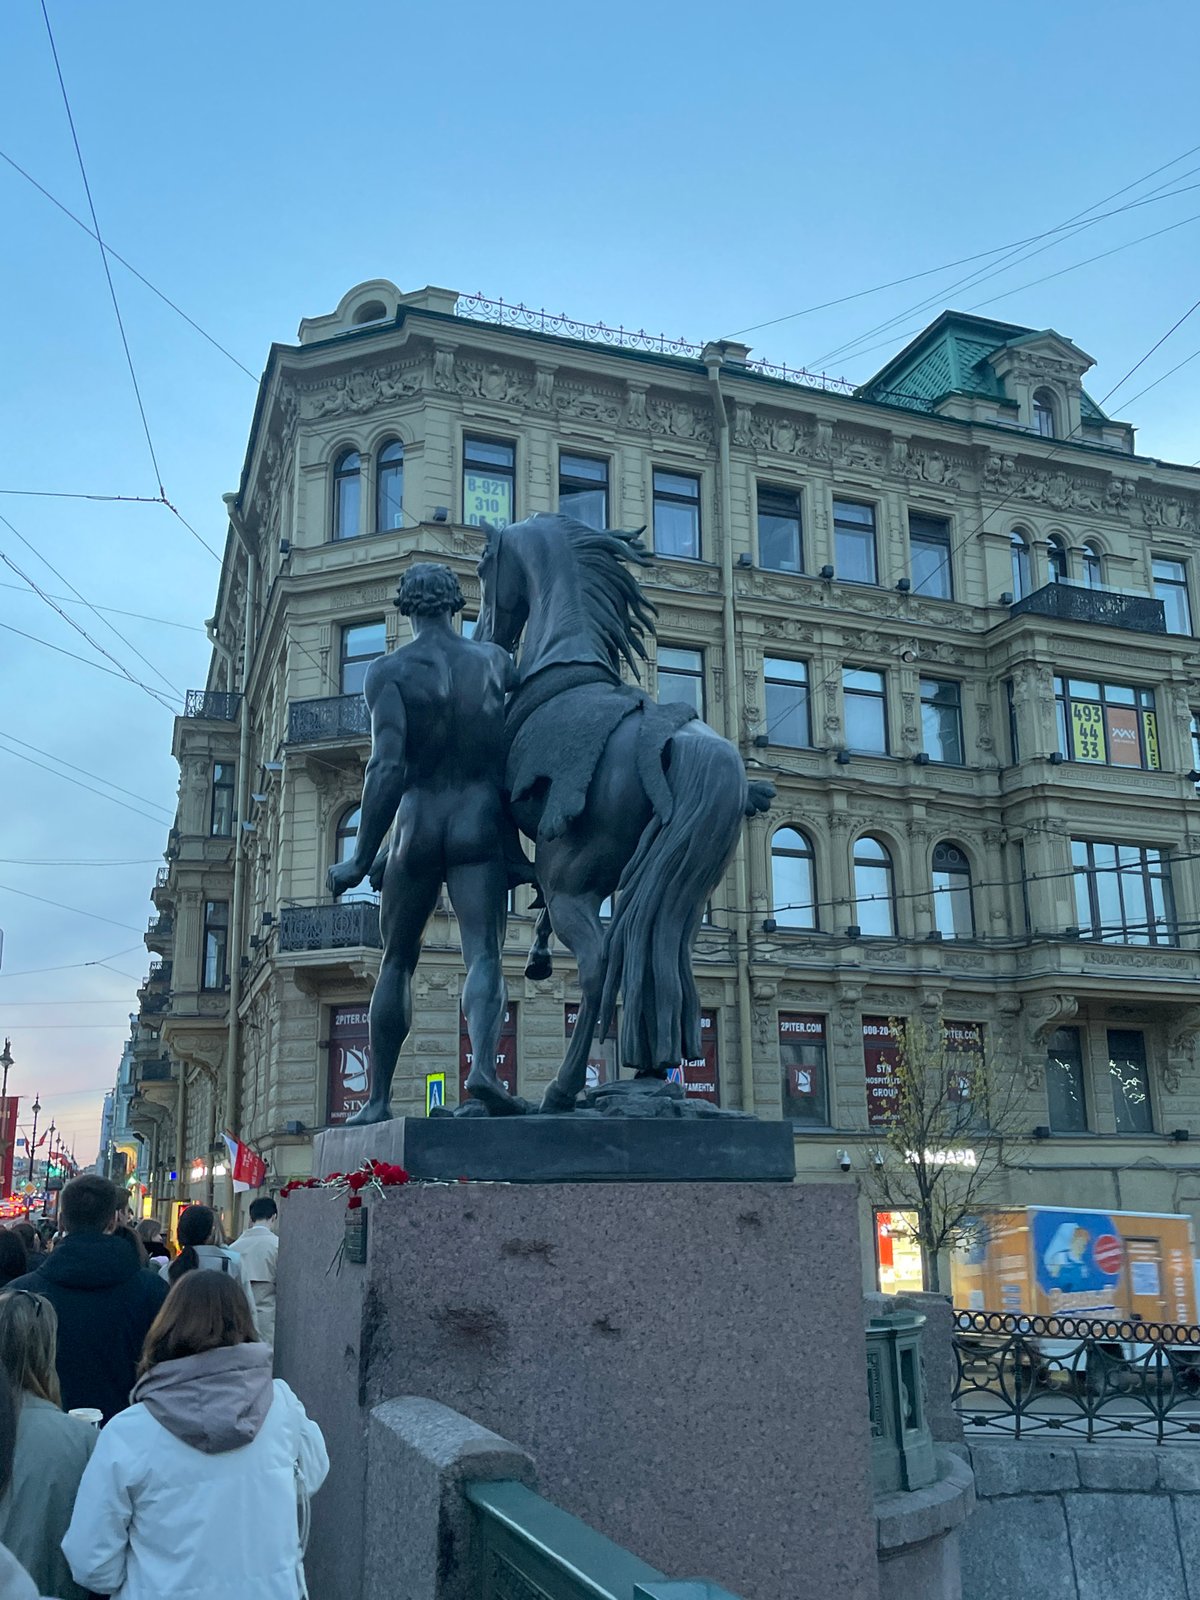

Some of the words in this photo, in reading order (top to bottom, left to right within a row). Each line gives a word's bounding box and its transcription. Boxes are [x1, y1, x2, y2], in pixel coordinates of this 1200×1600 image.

[475, 497, 498, 512] 310
[1073, 705, 1101, 723] 493
[1080, 723, 1098, 740] 44
[1147, 714, 1156, 766] SALE
[1081, 741, 1098, 758] 33
[336, 1014, 370, 1026] 2PITER.CO
[780, 1021, 822, 1033] 2PITER.COM
